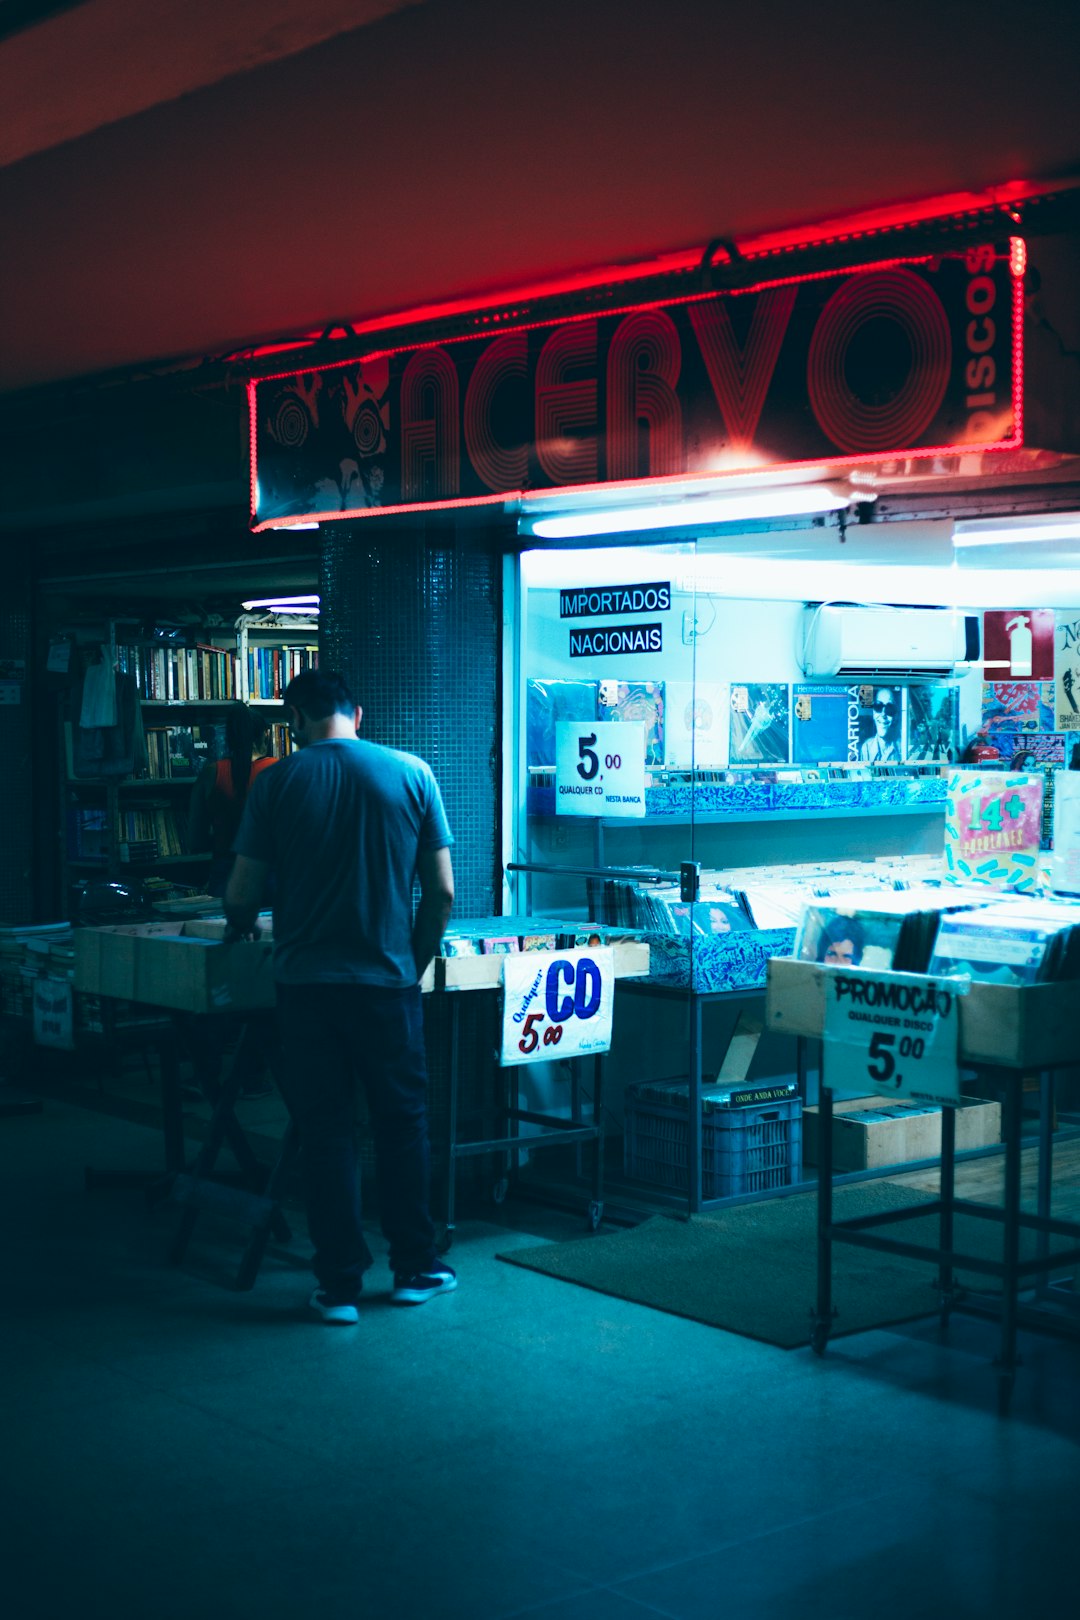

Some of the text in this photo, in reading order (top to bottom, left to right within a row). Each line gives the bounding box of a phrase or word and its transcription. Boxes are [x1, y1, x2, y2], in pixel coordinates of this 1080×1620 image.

[965, 243, 997, 441] DISCOS
[401, 266, 953, 500] ACERVO
[561, 588, 669, 615] IMPORTADOS
[571, 629, 661, 654] NACIONAIS
[847, 685, 859, 761] CARTOLA
[559, 785, 603, 795] QUALQUER CD
[605, 795, 641, 804] NESTA BANCA
[545, 957, 602, 1023] CD
[834, 975, 951, 1018] PROMOÇÃO
[518, 1013, 563, 1054] 5,00
[848, 1010, 934, 1032] QUALQUER DISCO
